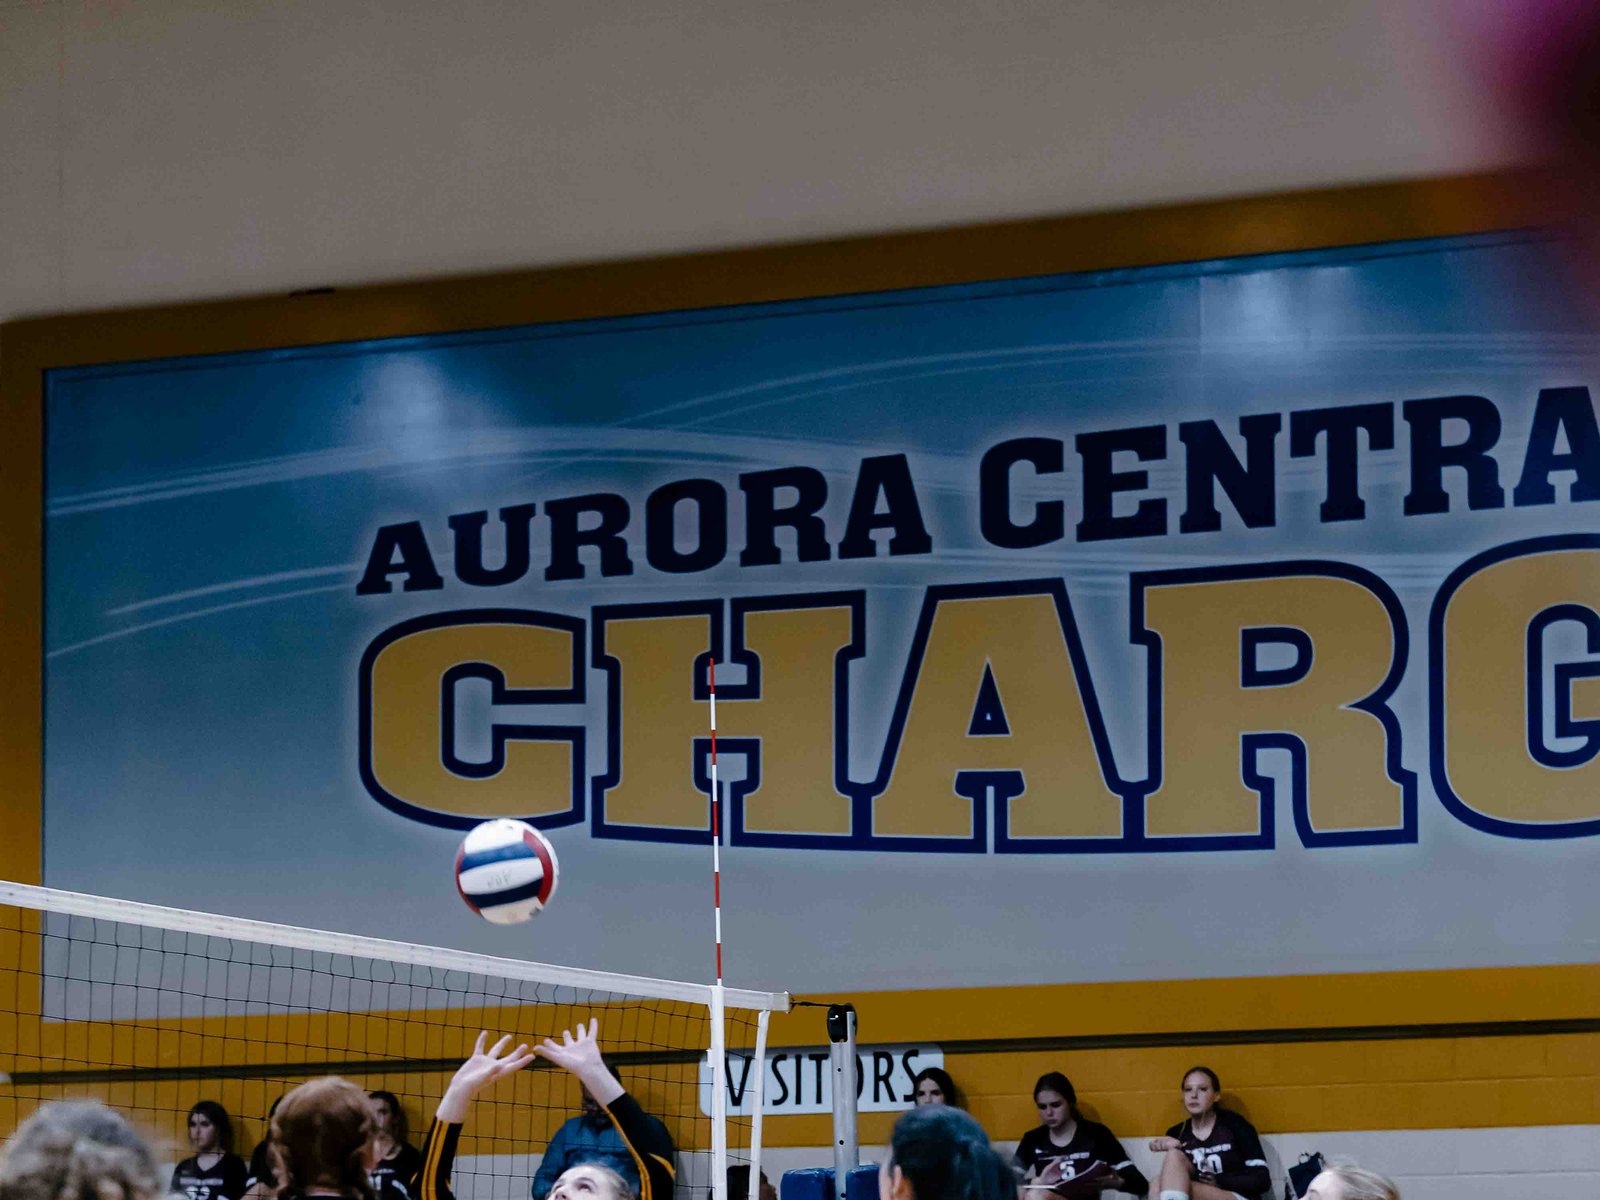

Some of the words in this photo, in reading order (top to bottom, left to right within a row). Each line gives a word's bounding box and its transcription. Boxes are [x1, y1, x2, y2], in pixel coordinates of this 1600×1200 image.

[356, 453, 933, 596] AURORA
[979, 386, 1600, 549] CENTRA
[359, 532, 1600, 855] CHARG
[724, 1049, 920, 1107] VSITRS
